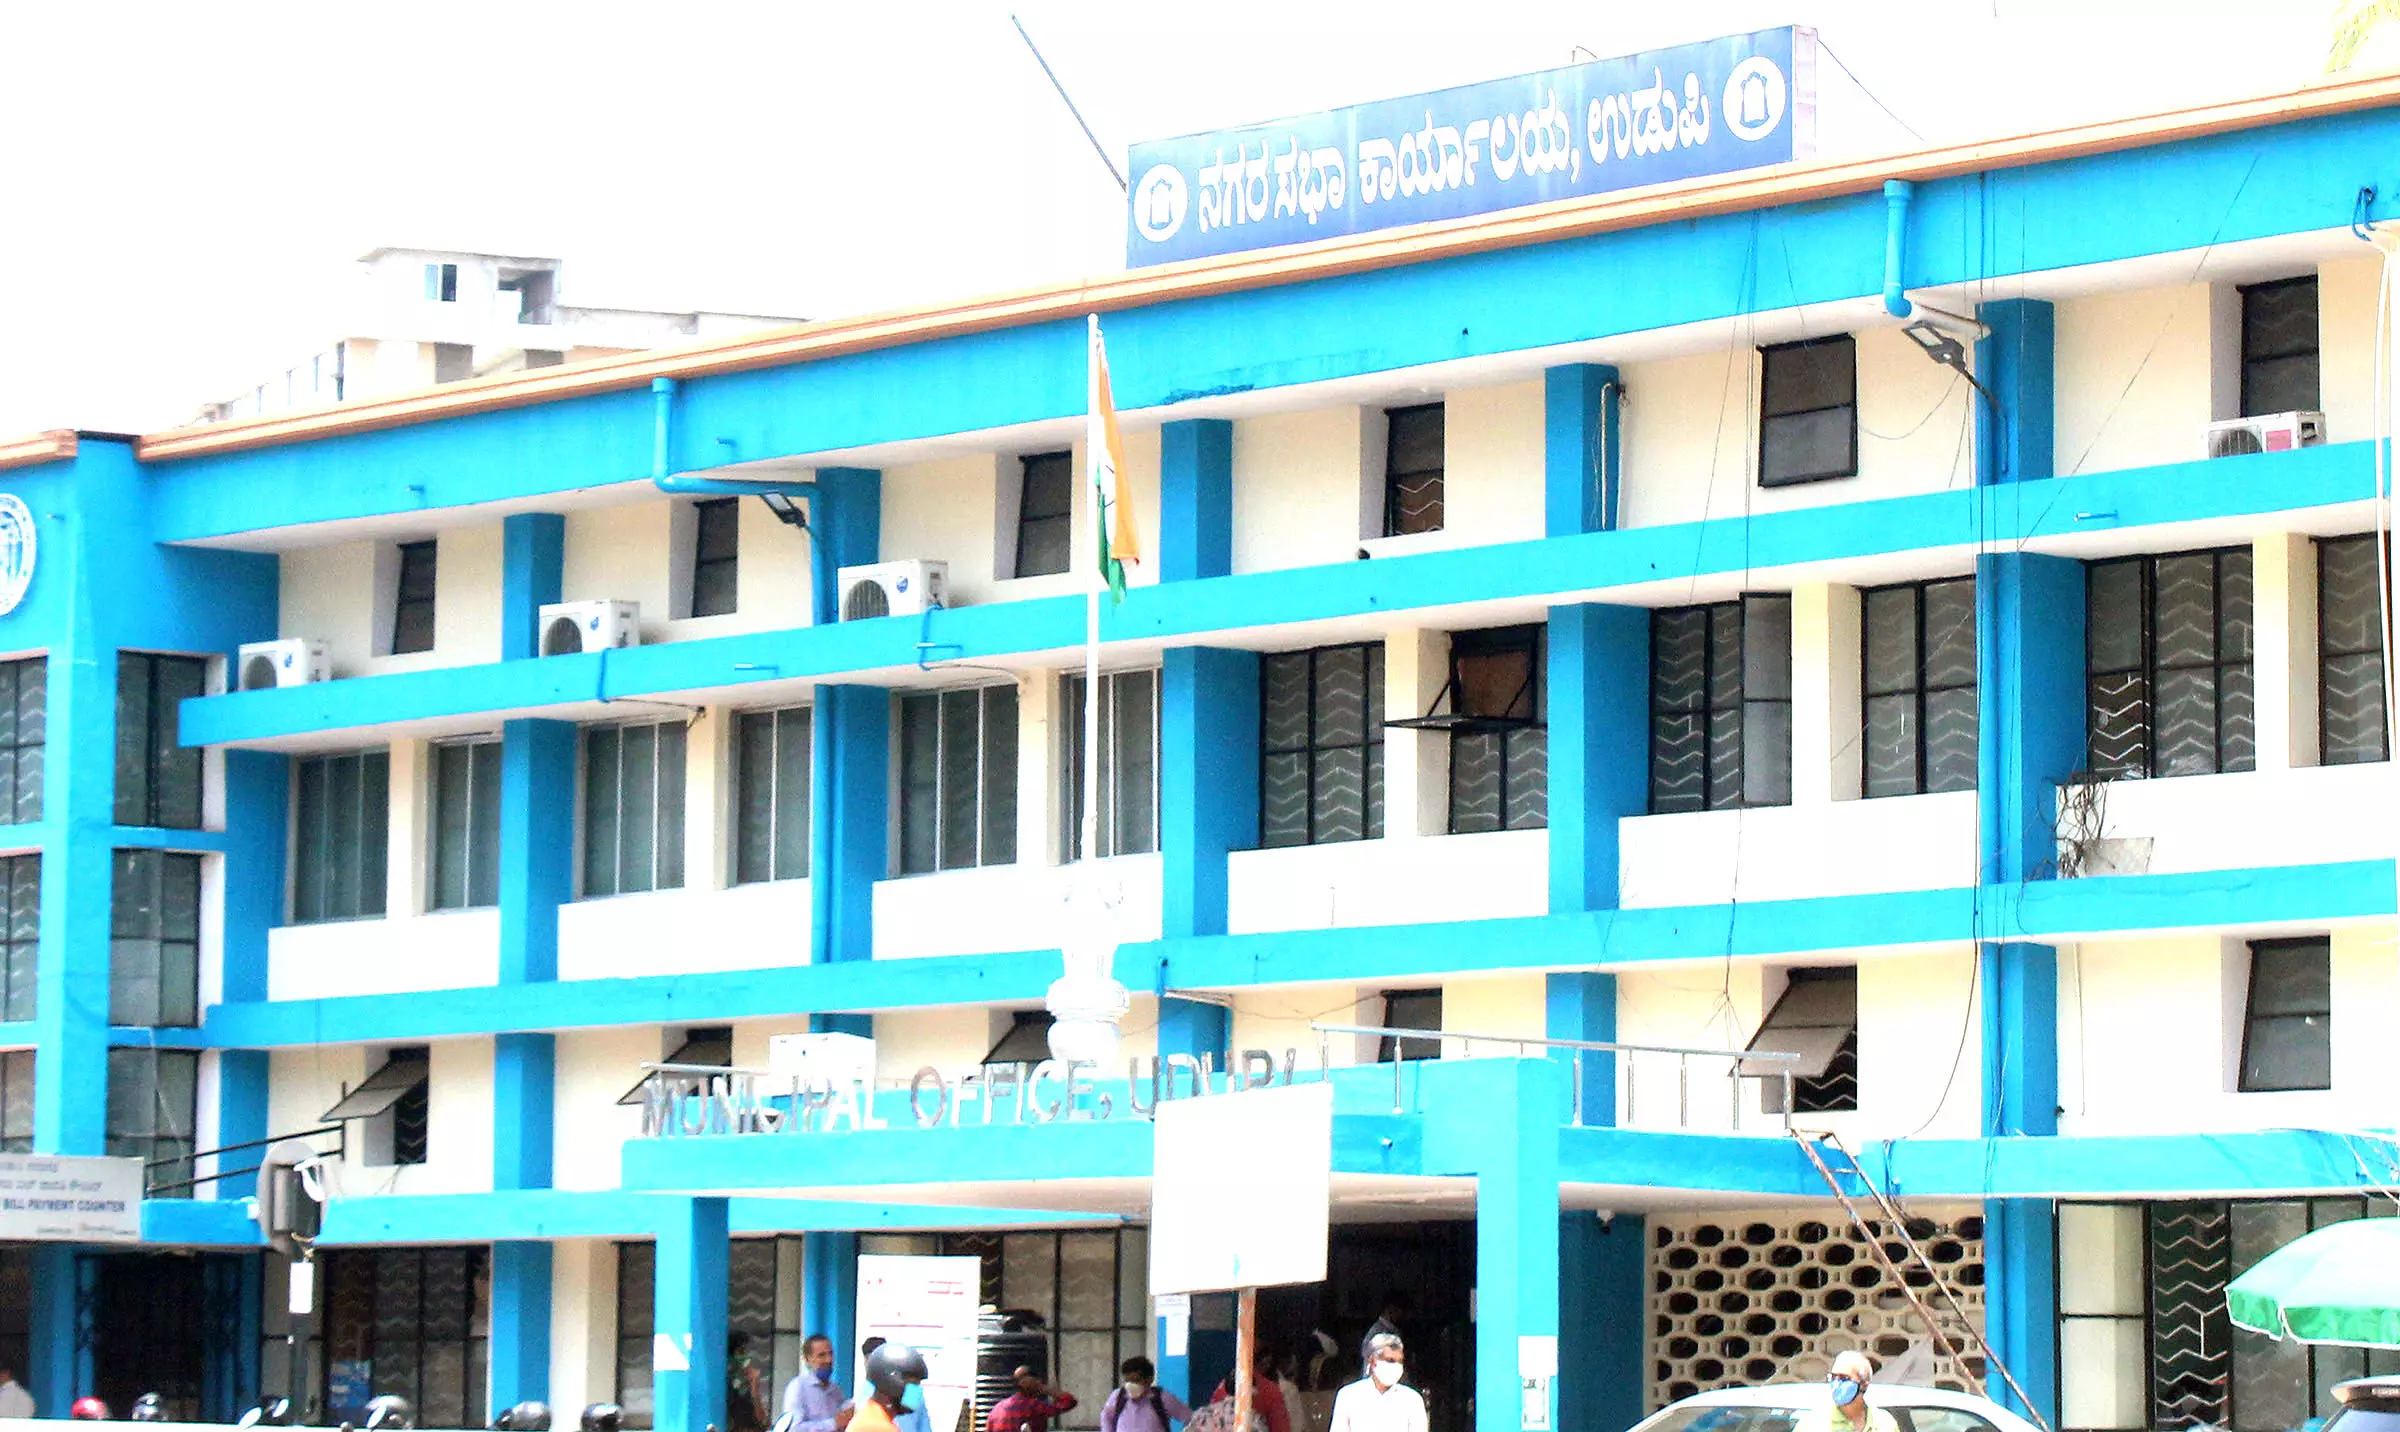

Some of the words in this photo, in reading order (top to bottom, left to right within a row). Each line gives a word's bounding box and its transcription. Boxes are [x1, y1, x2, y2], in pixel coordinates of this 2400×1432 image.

[1587, 65, 1711, 165] ಉಡುಪಿ
[910, 1058, 1112, 1128] OFFICE,
[1129, 1048, 1296, 1121] UDUPI
[28, 1198, 74, 1211] PAYMENT
[77, 1200, 125, 1213] COUNTER
